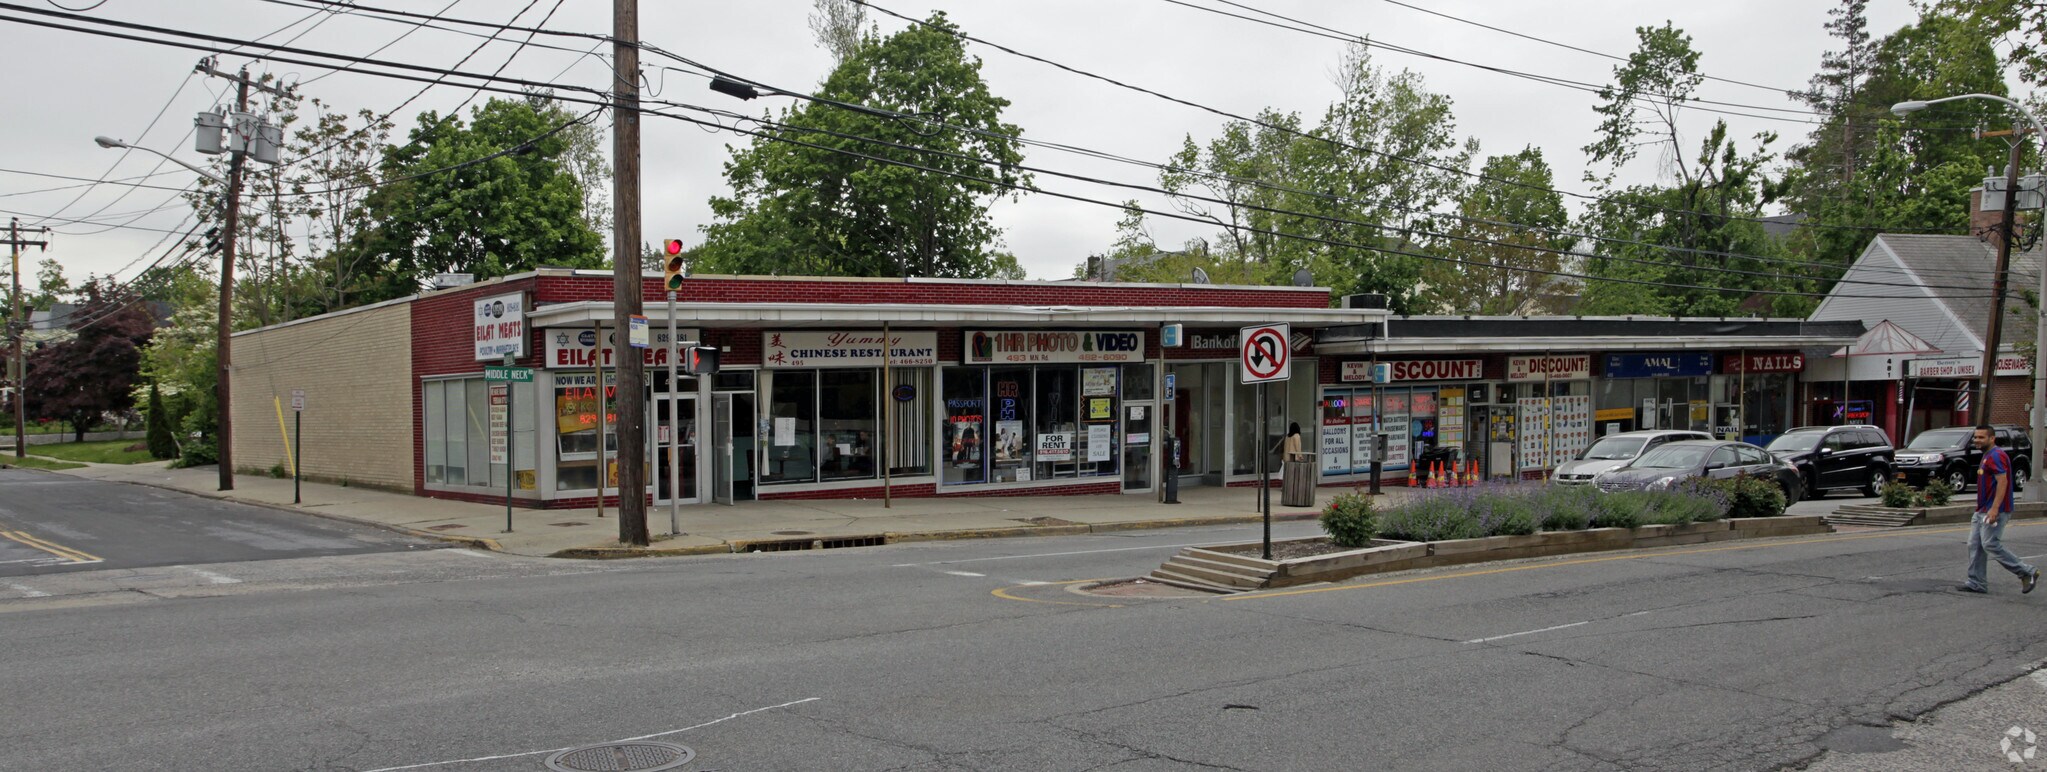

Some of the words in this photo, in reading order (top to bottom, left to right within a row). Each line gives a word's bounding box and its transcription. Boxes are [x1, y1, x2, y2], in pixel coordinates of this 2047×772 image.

[476, 324, 494, 342] EILAT
[498, 320, 521, 340] MEATS
[827, 332, 902, 347] Yummy
[1027, 333, 1078, 352] PHOTO
[1082, 332, 1093, 352] &
[1096, 333, 1138, 352] VIDEO
[557, 349, 612, 367] EILAT
[791, 349, 847, 358] CHINESE
[1529, 358, 1585, 373] DISCOUNT
[1644, 358, 1678, 369] AMAL
[1753, 356, 1801, 370] NAILS
[485, 369, 508, 379] MIDDLE
[511, 370, 528, 379] NECK
[1920, 367, 1939, 376] BARBER
[1940, 366, 1953, 375] SHOP
[1957, 366, 1975, 374] UNISEX
[555, 376, 573, 385] NOW
[574, 376, 585, 385] WE
[586, 375, 596, 384] AR
[948, 399, 982, 408] PASSPORT
